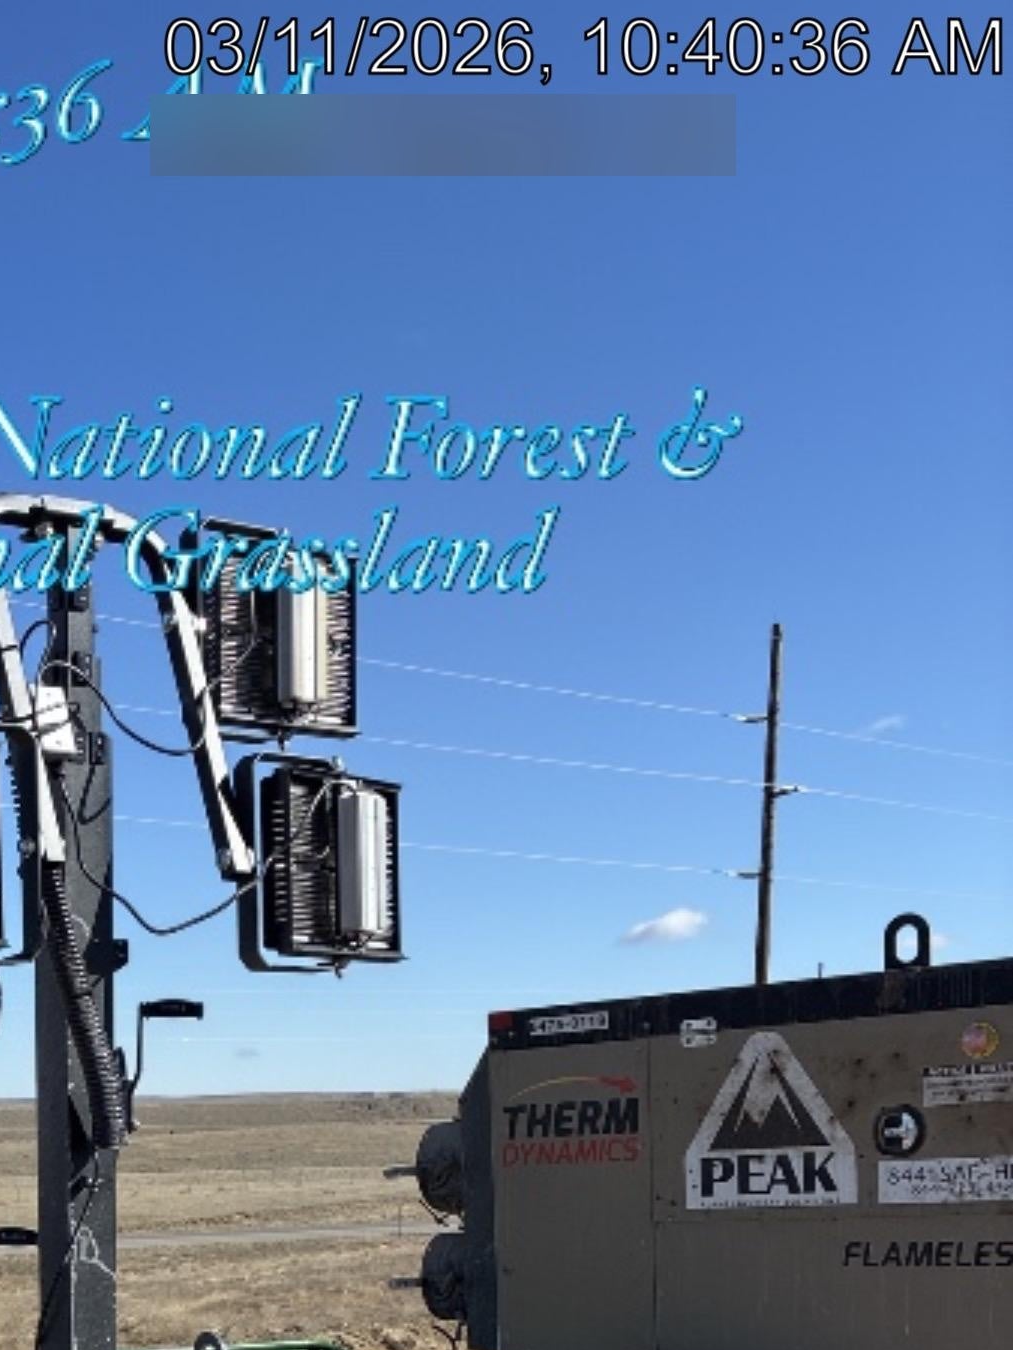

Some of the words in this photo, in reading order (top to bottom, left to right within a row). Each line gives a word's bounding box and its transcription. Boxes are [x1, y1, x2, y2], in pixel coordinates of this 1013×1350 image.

[502, 1097, 639, 1140] THERM
[501, 1136, 642, 1168] DYNAMICS
[700, 1151, 838, 1198] PEAK
